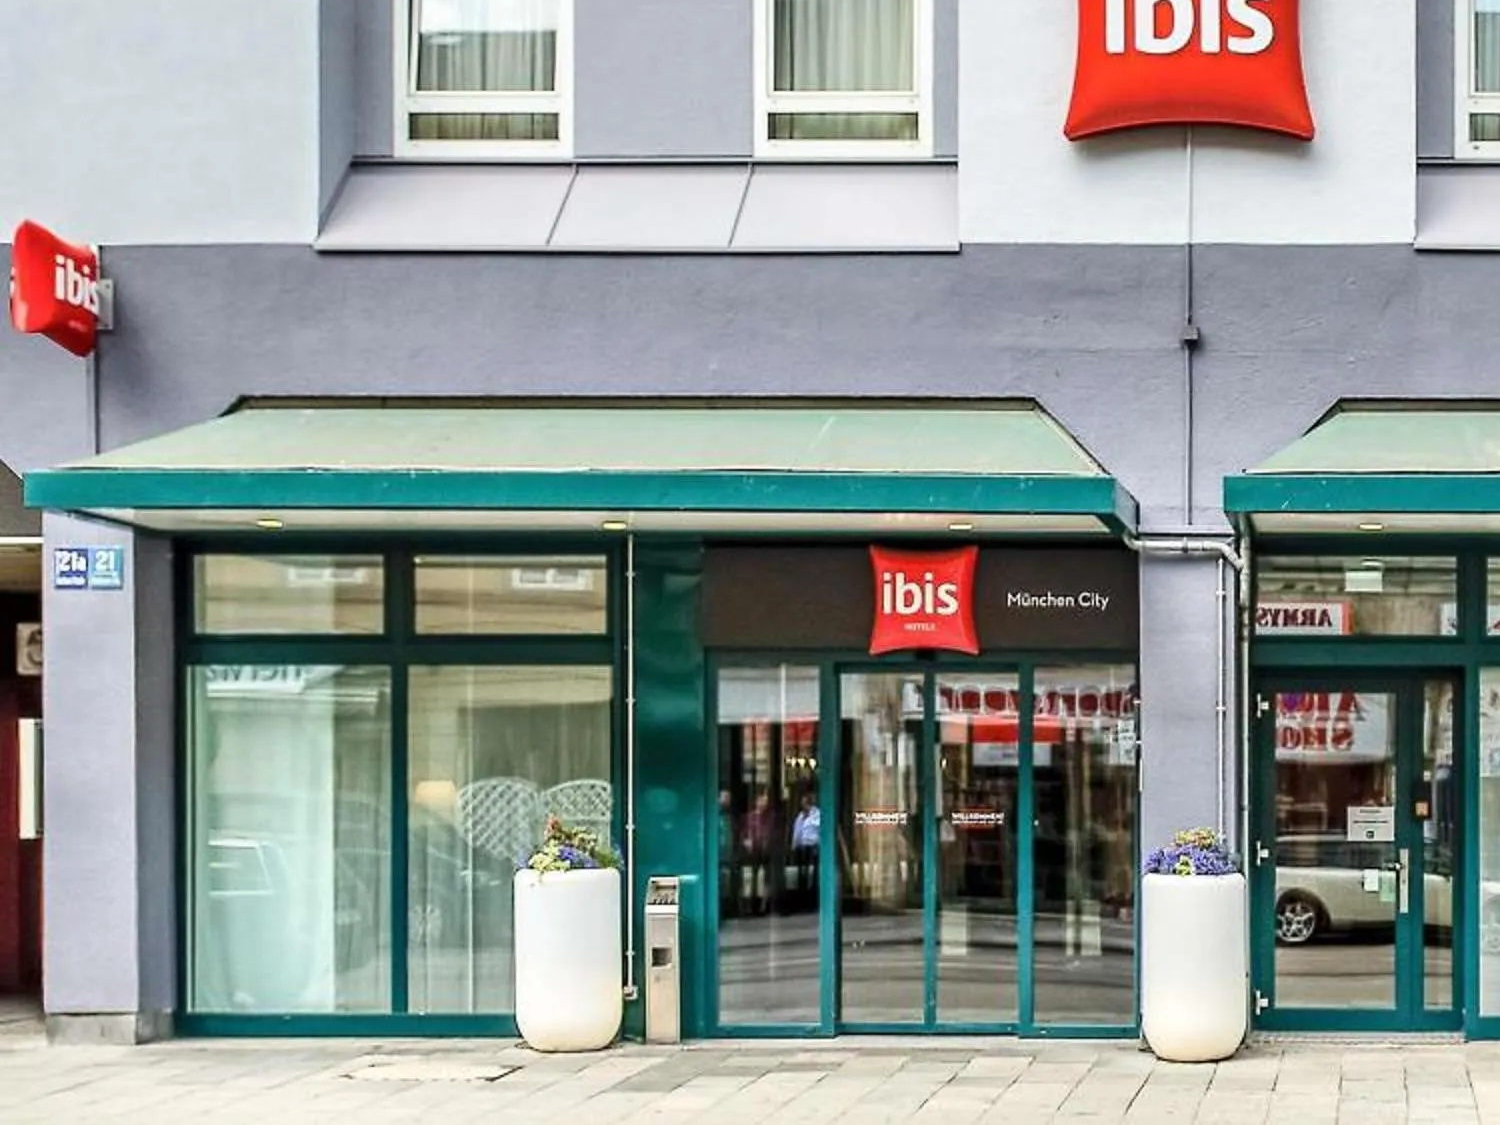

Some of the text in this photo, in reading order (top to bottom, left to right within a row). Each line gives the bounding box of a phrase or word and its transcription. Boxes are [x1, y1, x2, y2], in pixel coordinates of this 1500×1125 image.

[55, 253, 99, 315] ibis
[95, 550, 115, 572] 21
[882, 571, 960, 616] ibis
[1006, 591, 1110, 611] München City
